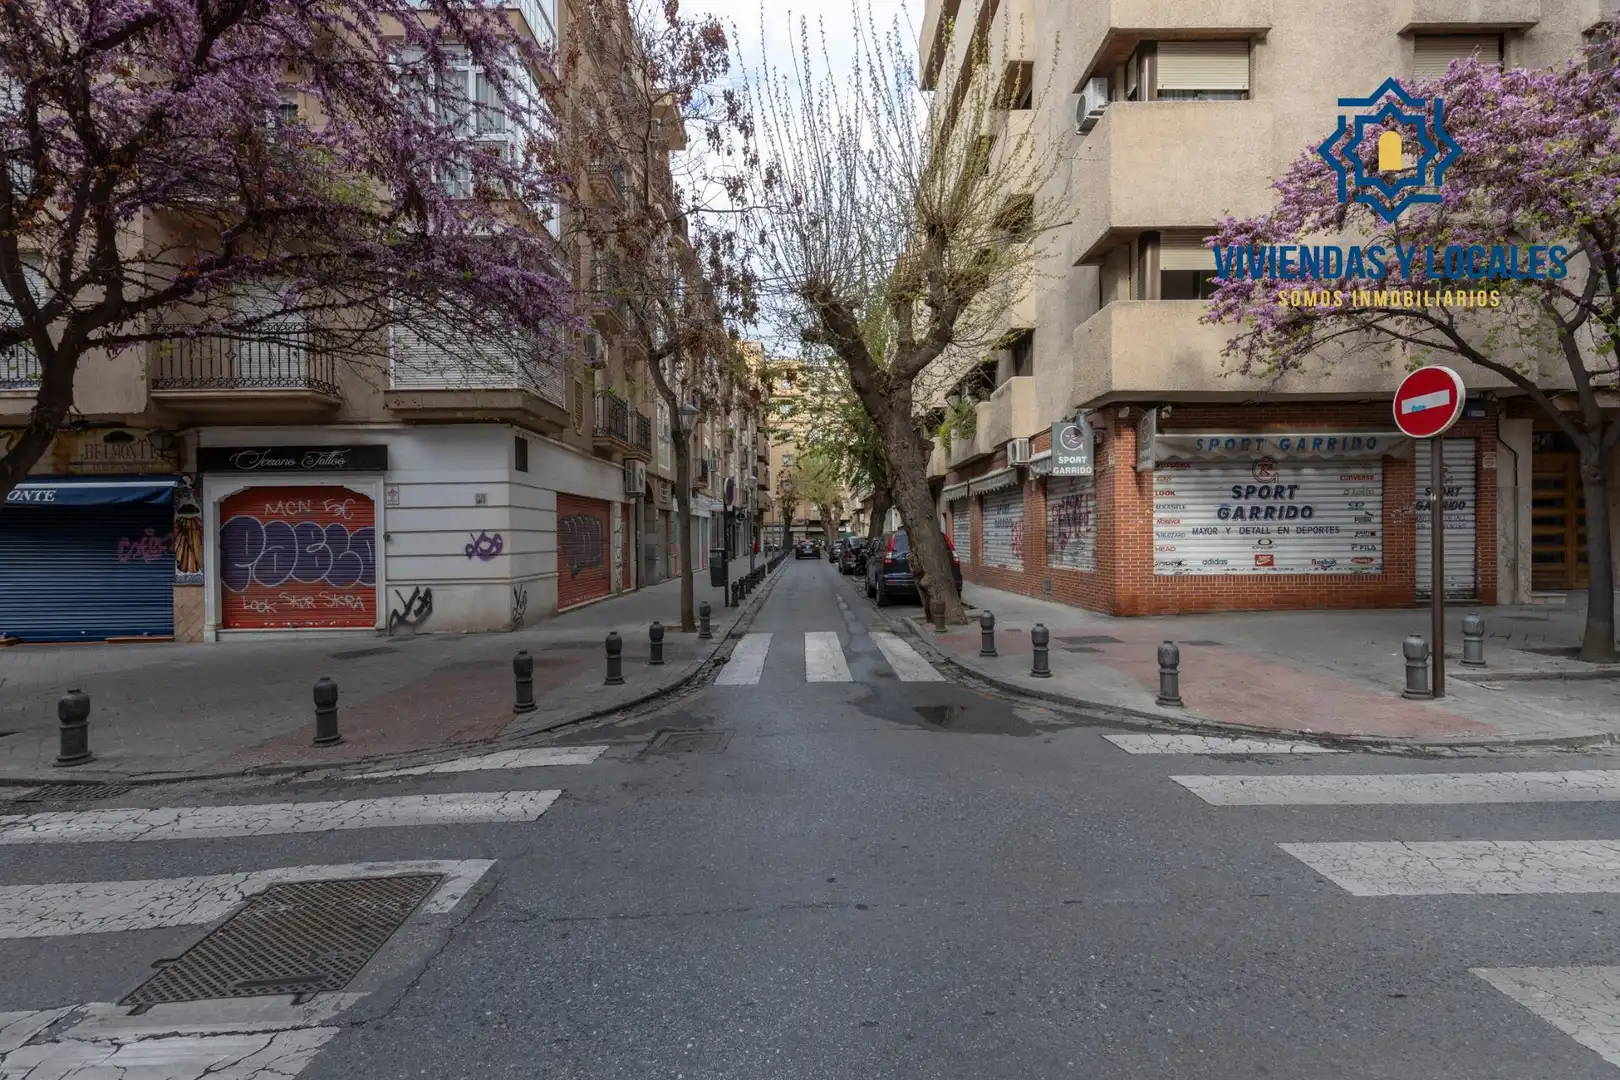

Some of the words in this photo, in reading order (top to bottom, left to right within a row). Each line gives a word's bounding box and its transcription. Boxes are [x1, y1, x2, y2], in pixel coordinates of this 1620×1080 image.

[1196, 437, 1265, 452] SPORT
[1279, 436, 1377, 451] GARRIDO
[301, 448, 352, 469] Tattoo
[1058, 456, 1088, 464] SPORT
[1053, 466, 1093, 475] GARRIDO
[1231, 484, 1300, 500] SPORT
[1216, 504, 1314, 521] GARRIDO
[1192, 526, 1219, 536] MAYOR
[1226, 526, 1232, 535] Y
[1239, 526, 1272, 535] DETALL
[1277, 526, 1290, 535] EN
[1295, 525, 1341, 535] DEPORTES
[1201, 557, 1229, 566] adidas
